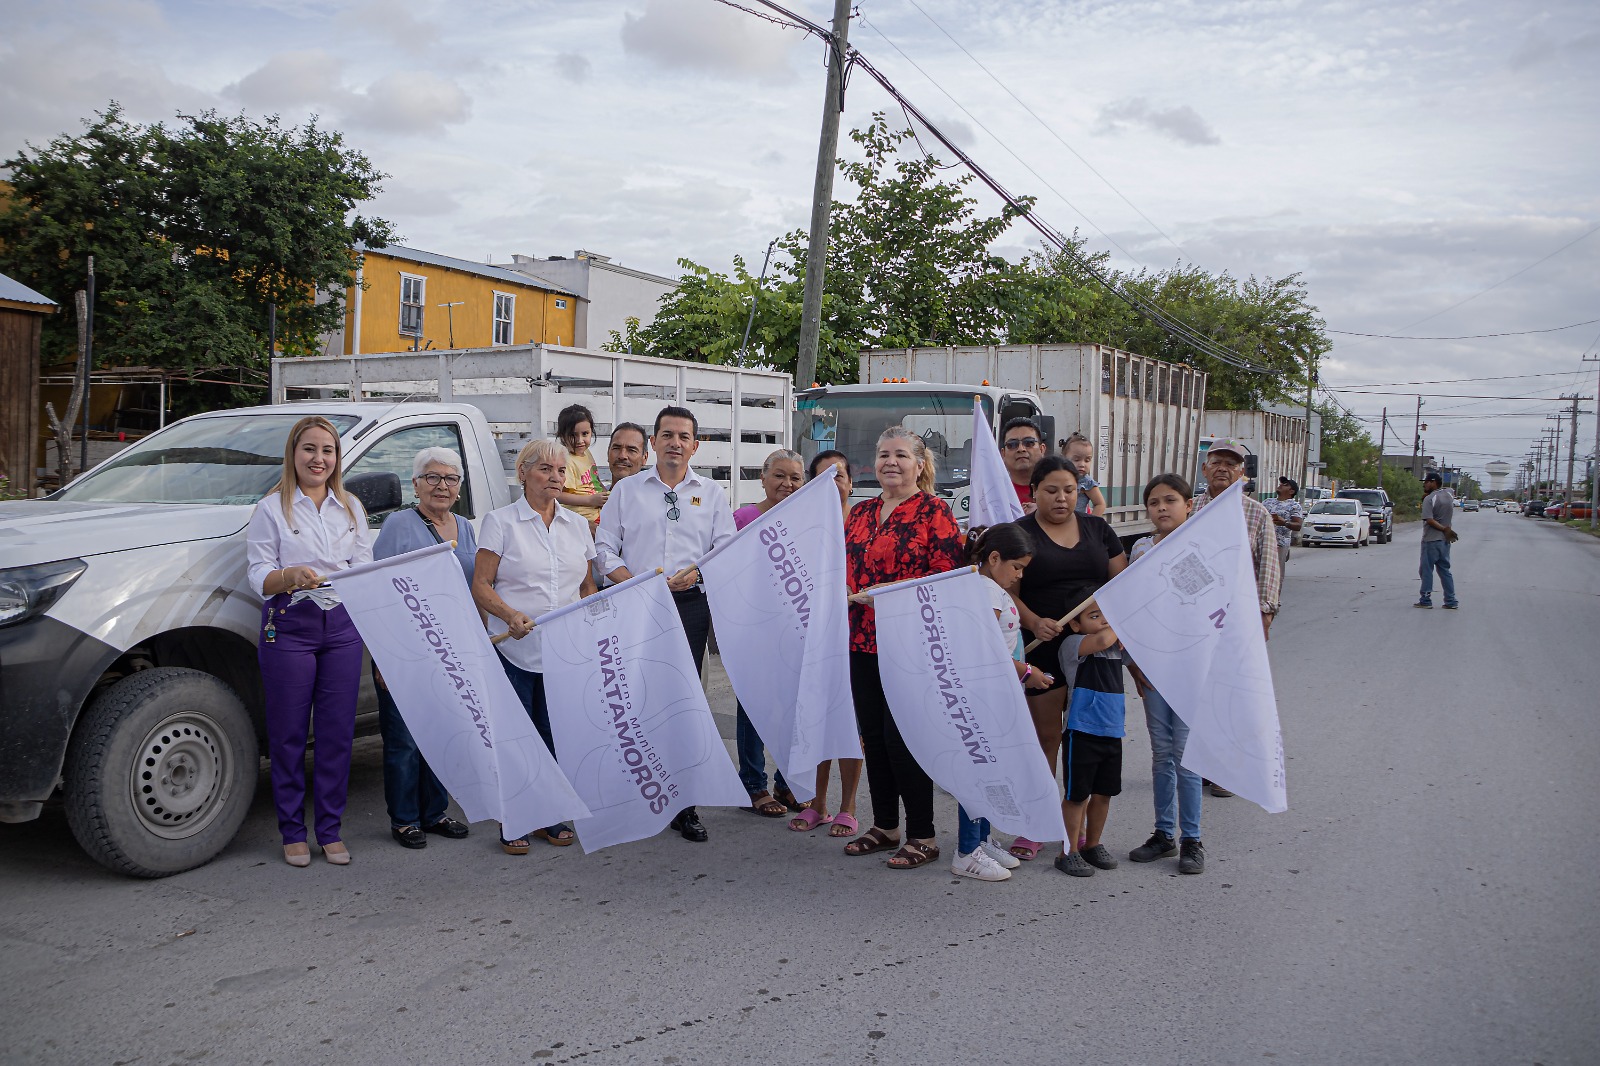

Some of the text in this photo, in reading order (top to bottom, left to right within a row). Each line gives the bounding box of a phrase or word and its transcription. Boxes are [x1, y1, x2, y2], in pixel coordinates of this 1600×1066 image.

[597, 637, 670, 815] MATAMOROS
[611, 635, 679, 799] Gobierno Municipal de
